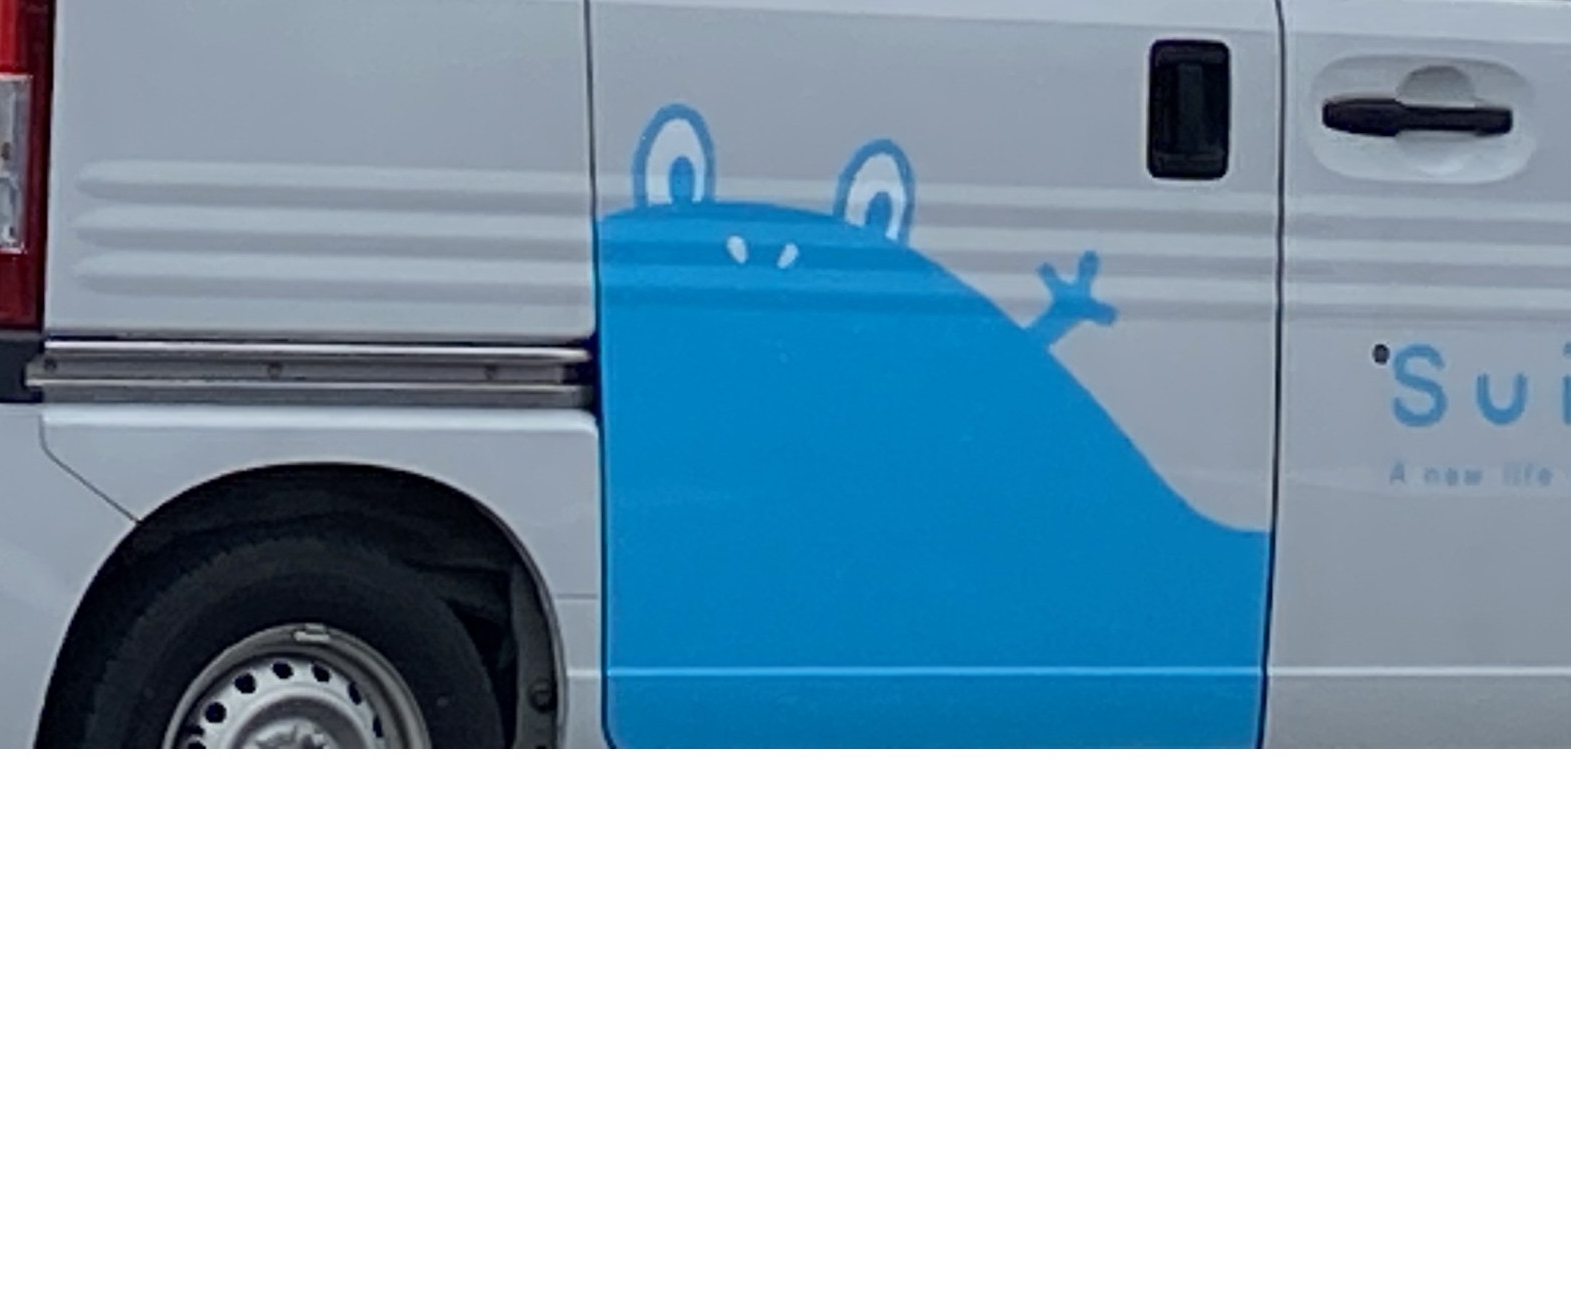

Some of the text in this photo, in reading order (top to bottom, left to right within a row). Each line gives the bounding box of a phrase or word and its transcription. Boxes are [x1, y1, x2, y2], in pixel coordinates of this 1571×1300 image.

[1389, 461, 1407, 486] A
[1423, 466, 1484, 486] new
[1503, 462, 1553, 486] life
